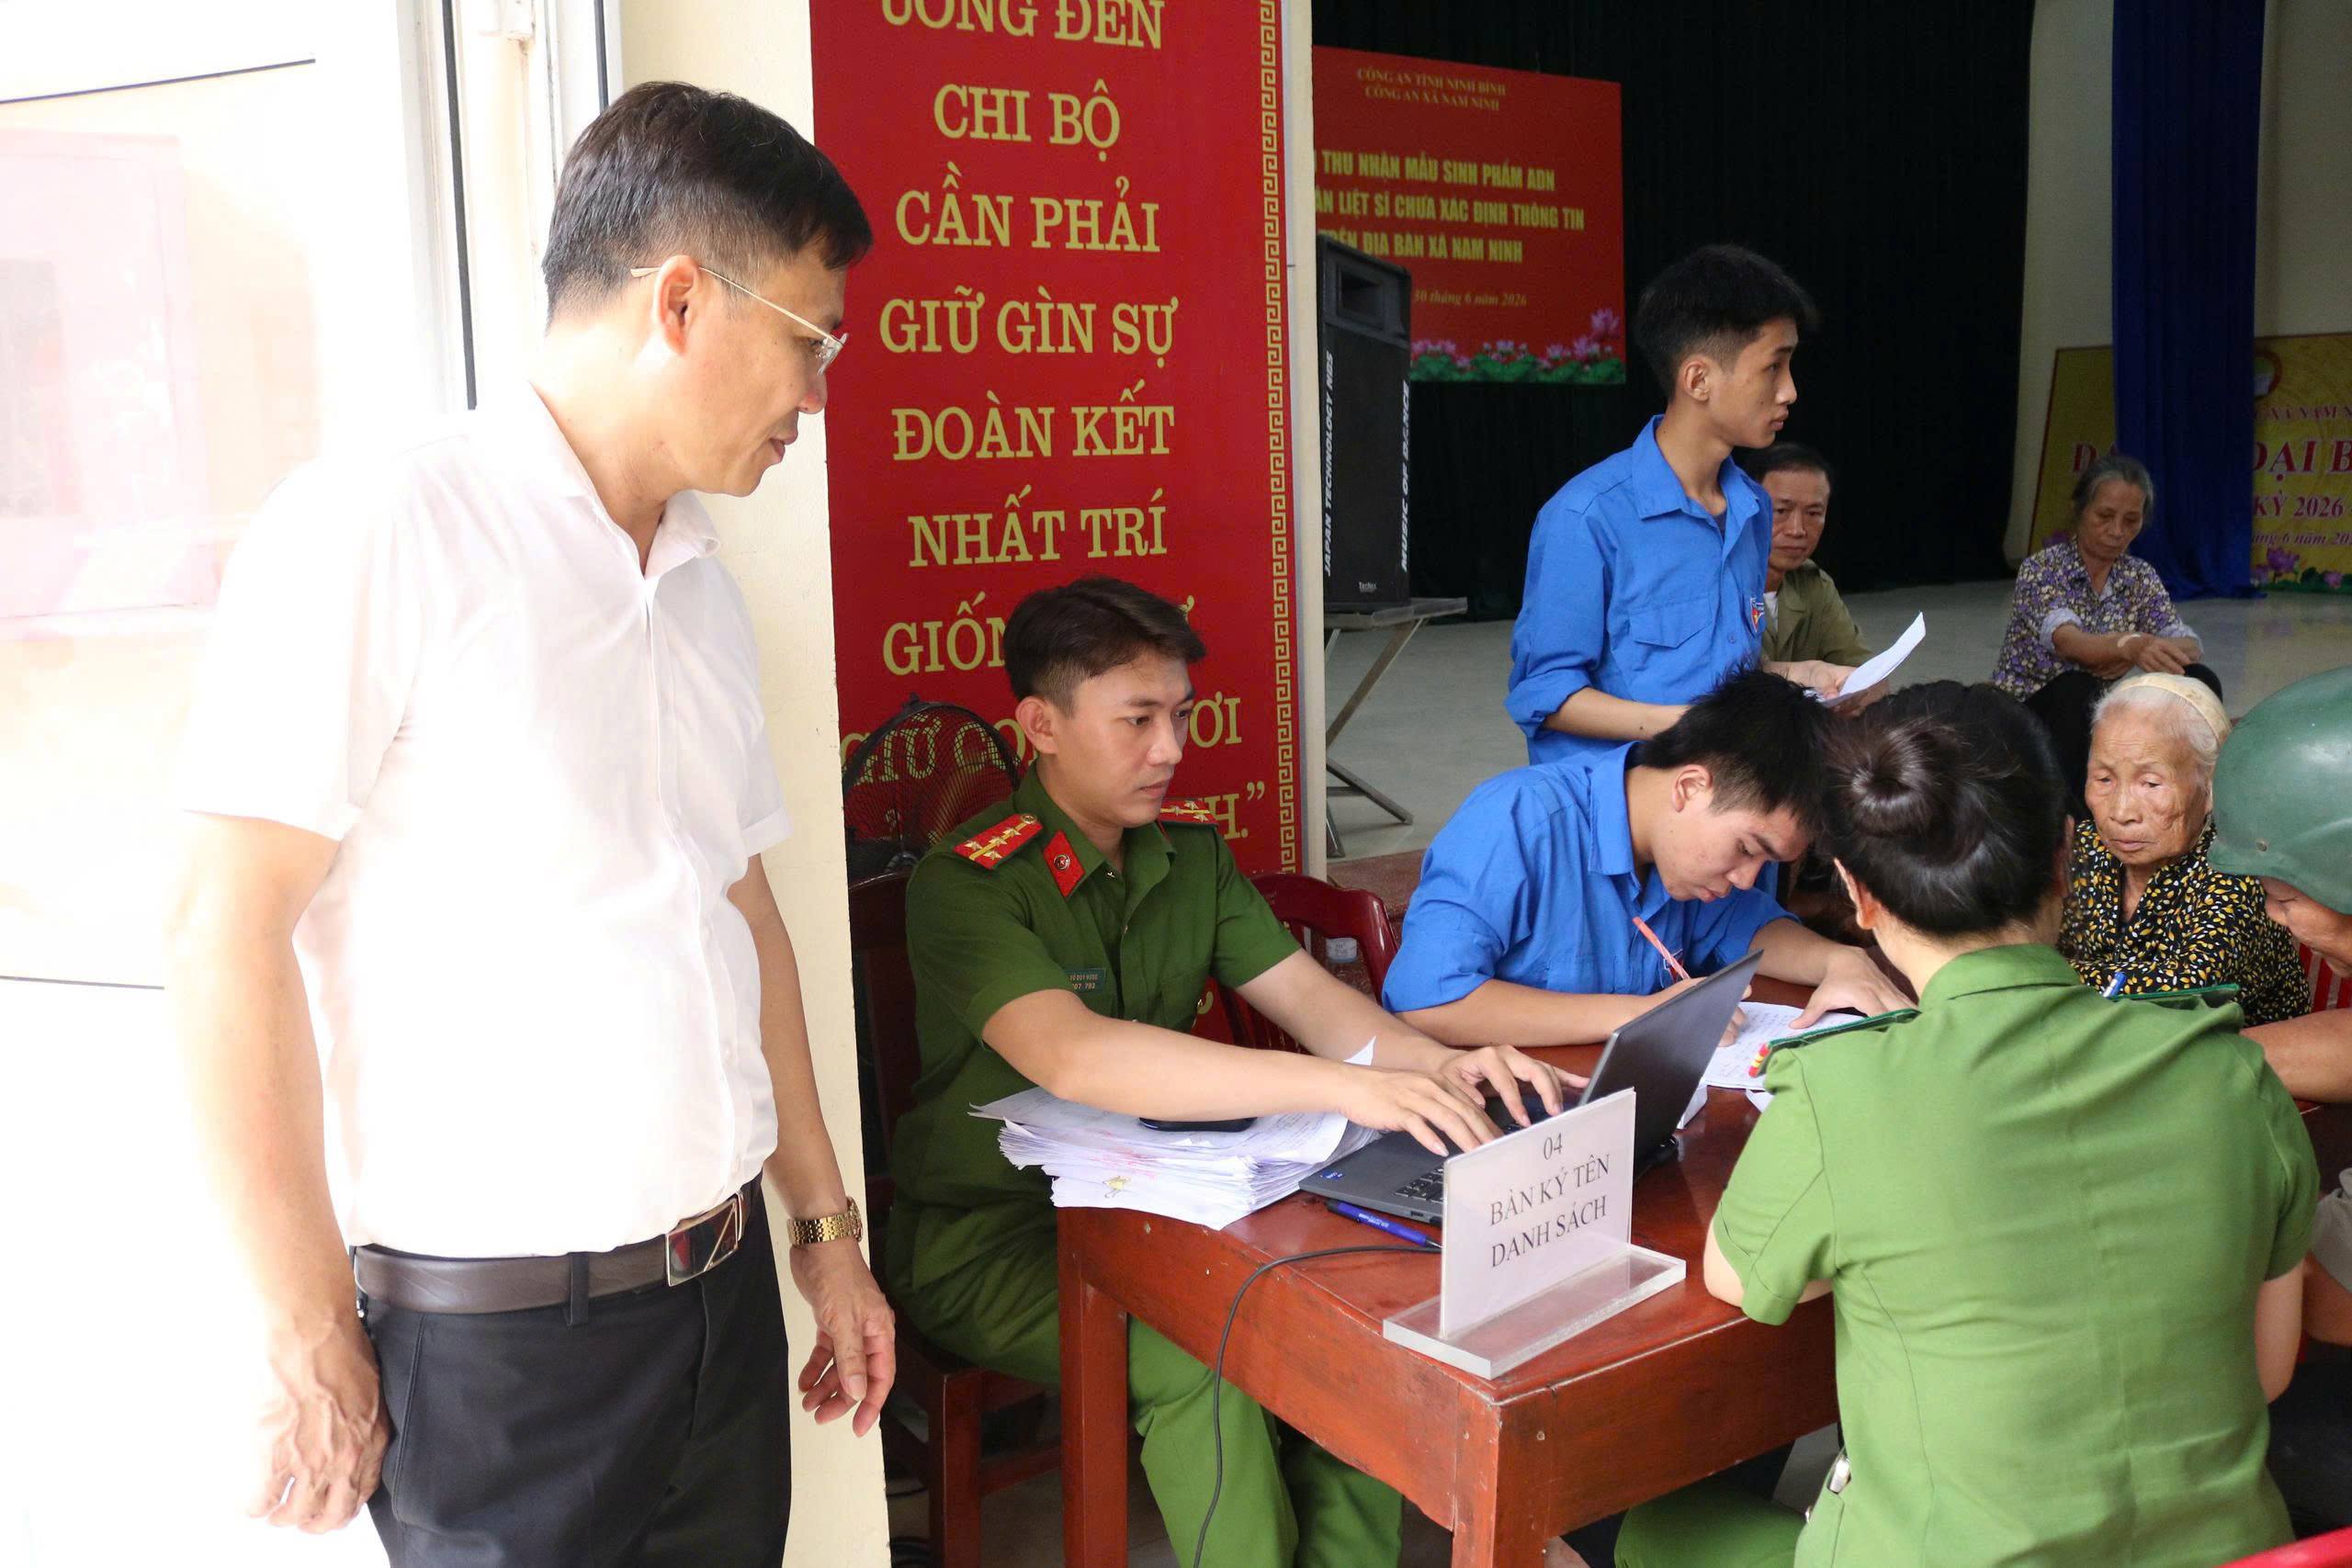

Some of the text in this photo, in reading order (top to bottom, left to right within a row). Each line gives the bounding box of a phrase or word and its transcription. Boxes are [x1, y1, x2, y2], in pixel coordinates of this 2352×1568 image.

[1396, 72, 1412, 85] AN
[1404, 90, 1419, 102] AN
[1442, 93, 1468, 108] NAM
[933, 79, 1120, 162] CHI BỘ
[896, 161, 1160, 253] CẦN PHẢI
[1321, 150, 1353, 175] THU
[1442, 159, 1478, 186] SINH
[1527, 166, 1555, 191] ADN
[1452, 235, 1485, 262] NAM
[1488, 239, 1523, 264] NINH
[1562, 207, 1585, 231] TIN
[879, 286, 1179, 368] GIỮ GÌN SỰ
[891, 379, 1174, 460] ĐOÀN KẾT
[1325, 391, 1333, 510] TECHNOLOGY
[1401, 379, 1410, 573] MUSIC OF DANCE
[2293, 496, 2345, 518] 2026
[908, 484, 1168, 568] NHẤT TRÍ
[883, 591, 1005, 676] GIỐ
[1544, 1133, 1564, 1161] 04
[1490, 1154, 1611, 1226] BÀN KÝ TÊN
[1492, 1194, 1608, 1269] DANH SÁCH
